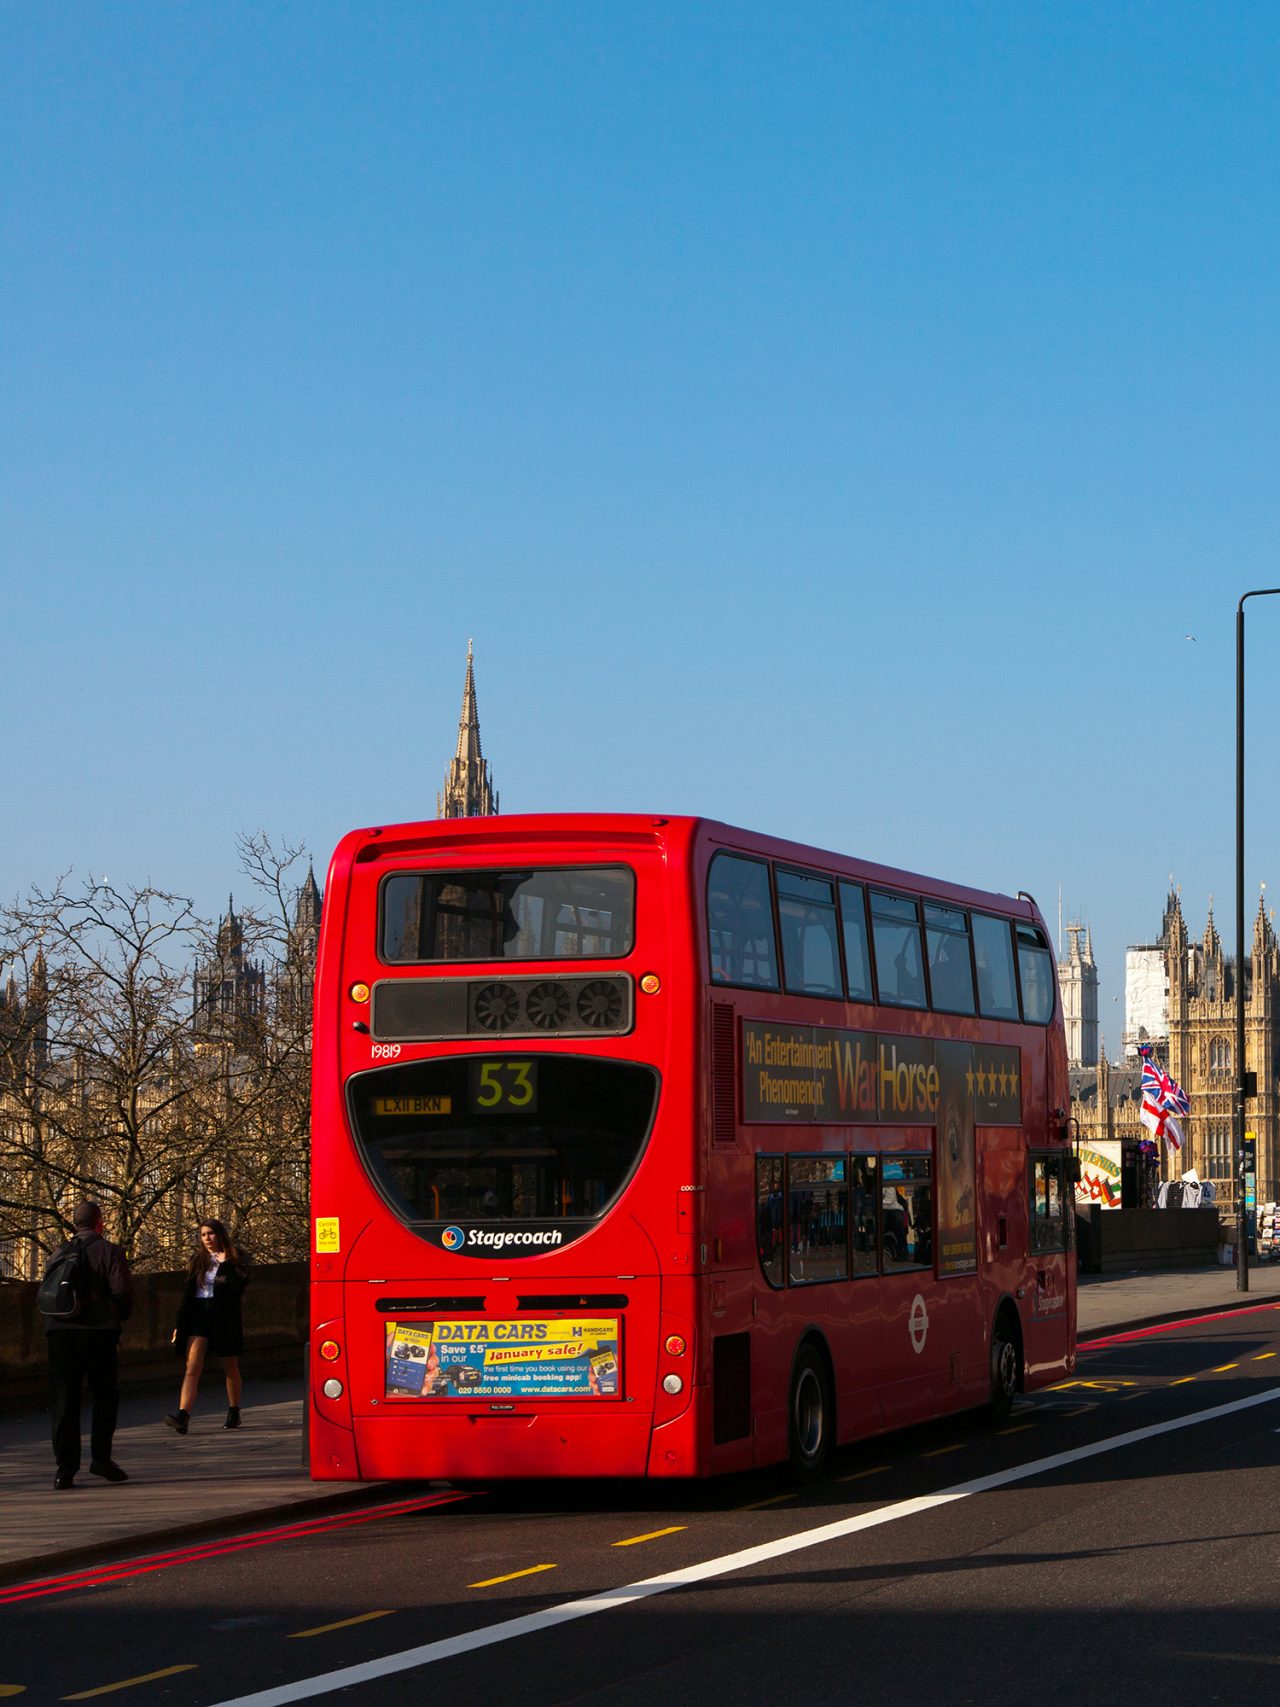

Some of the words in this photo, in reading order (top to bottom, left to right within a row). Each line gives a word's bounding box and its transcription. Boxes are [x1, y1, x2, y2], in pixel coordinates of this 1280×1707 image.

[371, 1044, 402, 1059] 19819
[764, 1033, 833, 1070] Entertainment
[834, 1040, 878, 1112] War
[879, 1044, 941, 1113] Horse
[476, 1061, 534, 1108] 53
[413, 1097, 441, 1111] BKN
[1072, 1149, 1122, 1178] VENIRS
[680, 1184, 705, 1192] COOL
[467, 1229, 563, 1250] Stagecoach
[437, 1324, 490, 1341] DATA
[493, 1323, 549, 1340] CARS
[440, 1344, 467, 1355] Save
[489, 1347, 544, 1361] January
[547, 1342, 584, 1355] sale!
[441, 1354, 450, 1363] in
[452, 1355, 468, 1363] our
[495, 1365, 509, 1373] first
[510, 1365, 525, 1373] time
[526, 1367, 538, 1375] you
[539, 1365, 555, 1373] book
[557, 1365, 576, 1375] using
[483, 1374, 499, 1382] free
[501, 1373, 531, 1382] minicab
[533, 1373, 563, 1384] booking
[565, 1374, 583, 1384] app!
[458, 1387, 472, 1395] 020
[493, 1386, 512, 1394] 0000
[520, 1385, 591, 1395] www.datacars.com
